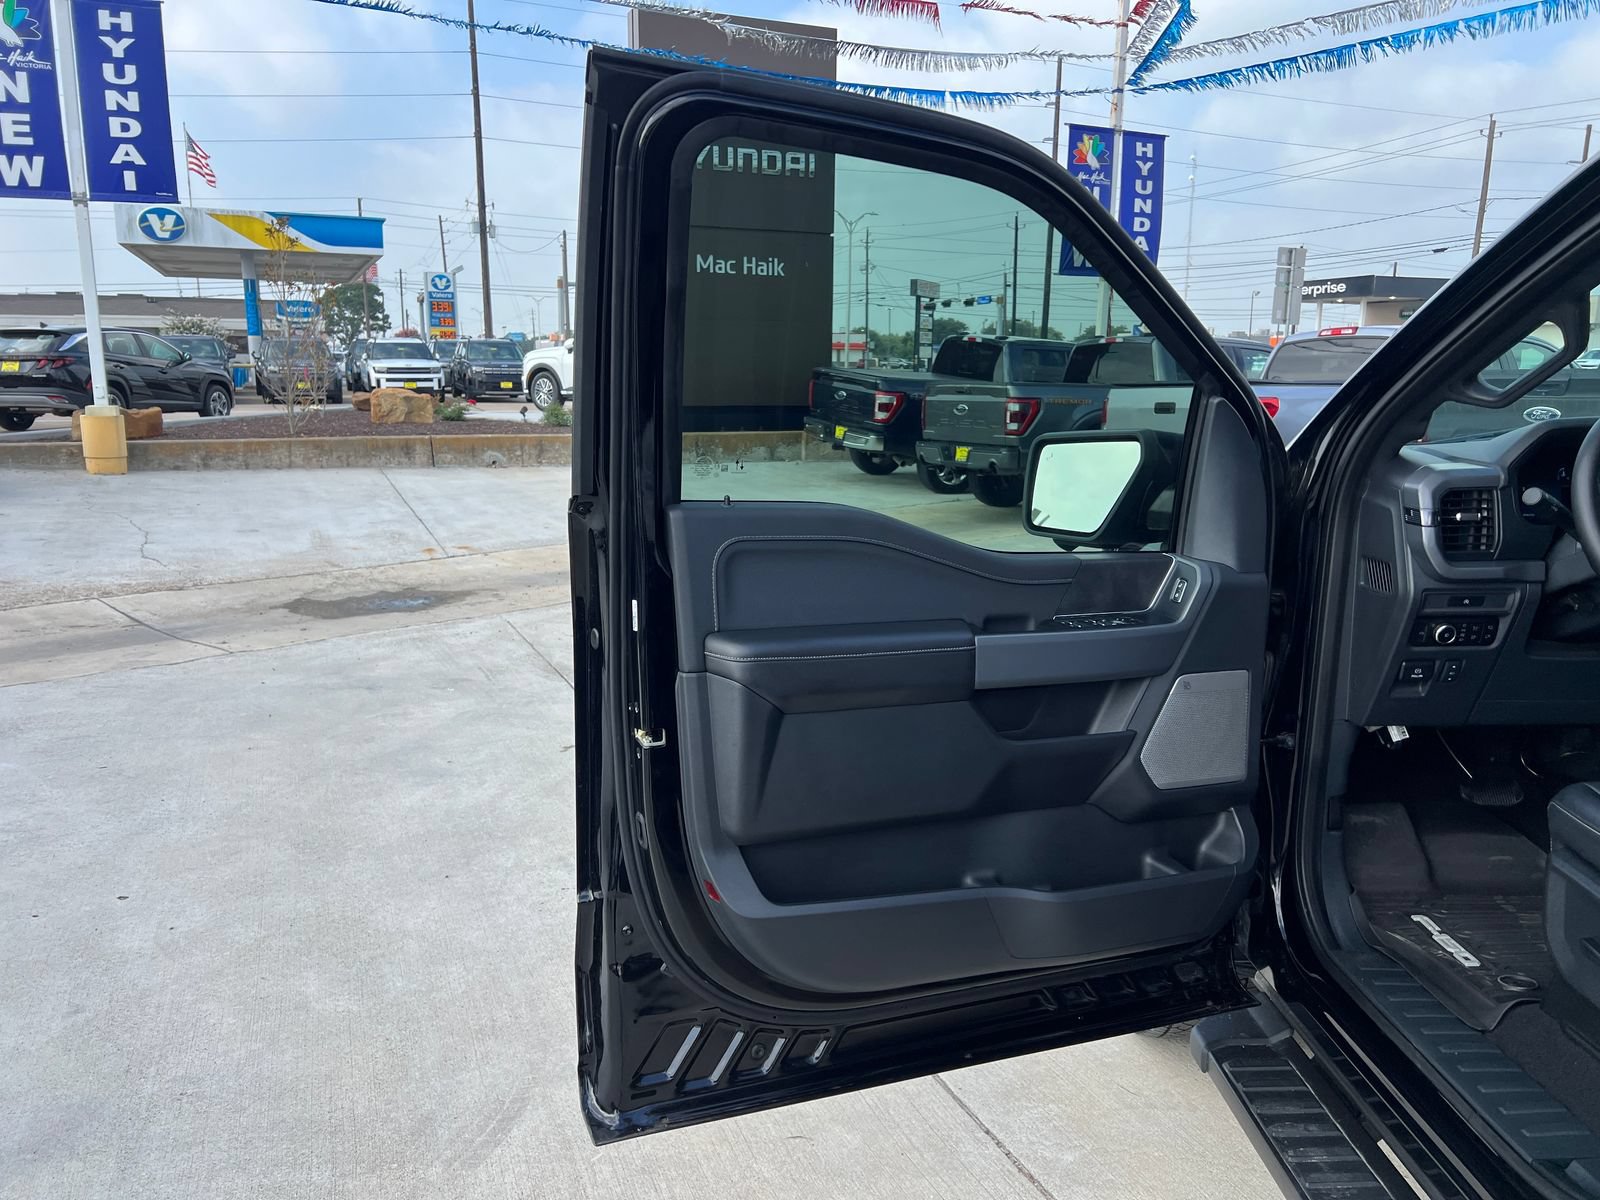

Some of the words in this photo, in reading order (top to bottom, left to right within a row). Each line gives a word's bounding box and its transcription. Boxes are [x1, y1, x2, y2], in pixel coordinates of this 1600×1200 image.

[15, 62, 53, 70] VICTORIA
[97, 9, 147, 192] HYUNDAI
[0, 71, 45, 188] NEW
[696, 145, 816, 178] YUNDAI
[1132, 141, 1154, 251] HYUNDA
[696, 254, 737, 274] Mac
[743, 256, 785, 276] Haik
[1301, 281, 1347, 298] erprise
